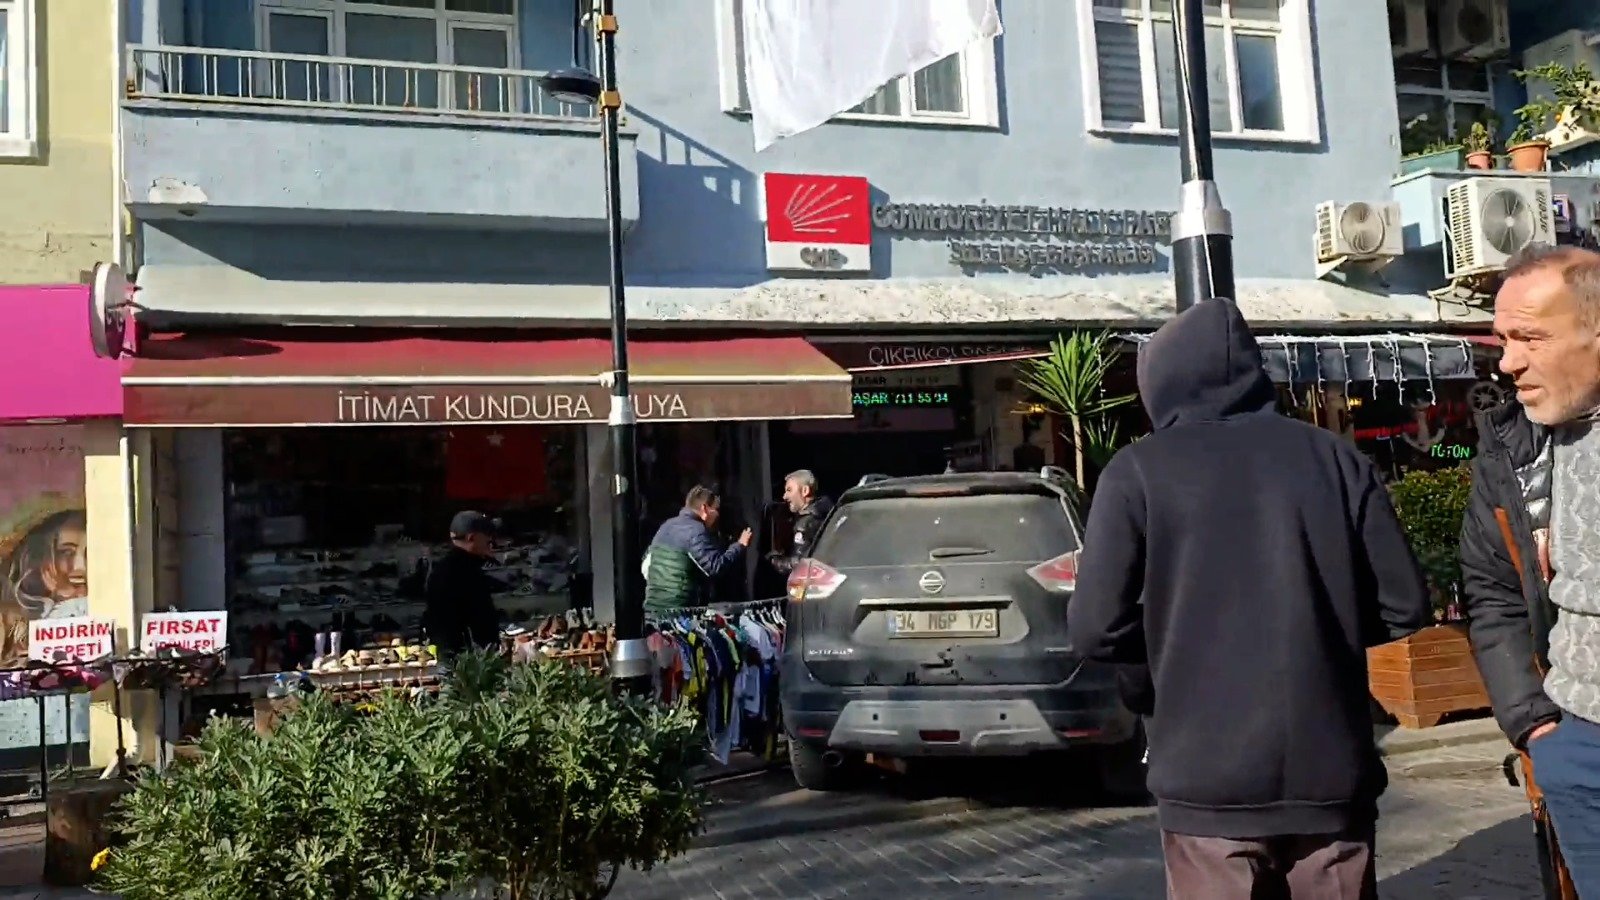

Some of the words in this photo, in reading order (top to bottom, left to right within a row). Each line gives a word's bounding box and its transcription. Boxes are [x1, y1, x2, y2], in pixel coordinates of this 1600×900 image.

[1123, 209, 1177, 236] PAR
[338, 390, 436, 420] İTİMAT
[445, 395, 593, 420] KUNDURA
[628, 394, 688, 417] UYA
[853, 392, 888, 406] AŞAR
[146, 619, 221, 635] FIRSAT
[896, 613, 915, 630] 34
[968, 612, 994, 629] 179
